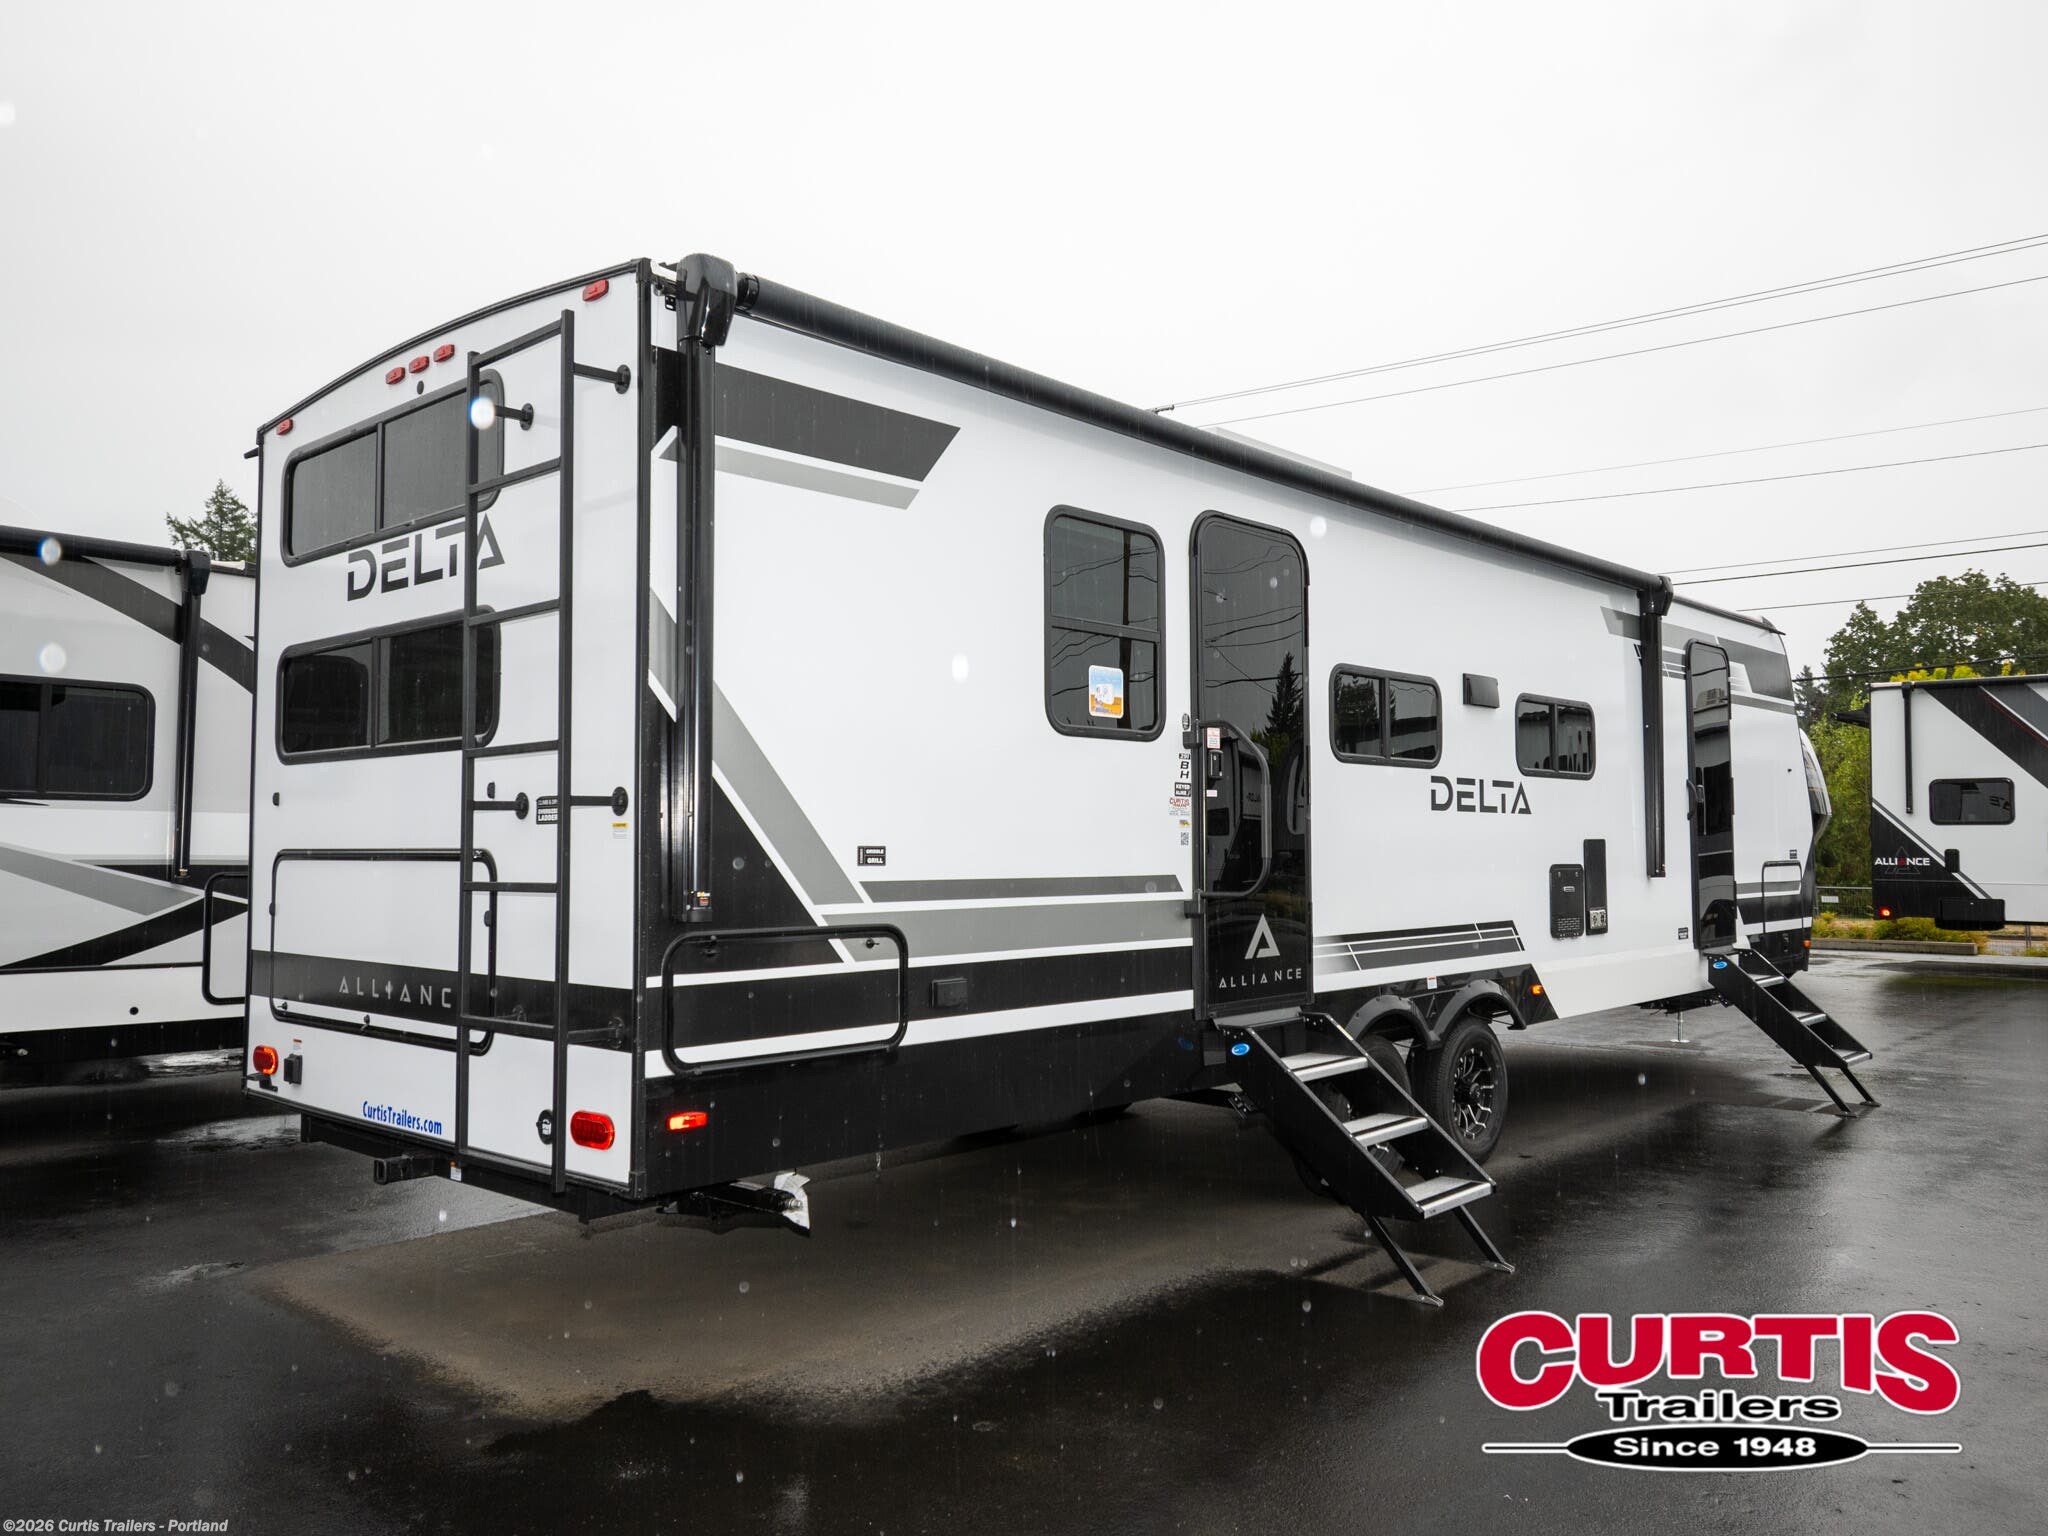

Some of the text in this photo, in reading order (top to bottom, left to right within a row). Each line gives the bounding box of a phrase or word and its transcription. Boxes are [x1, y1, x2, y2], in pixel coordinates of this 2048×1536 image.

[347, 513, 505, 601] DELTA
[1430, 775, 1532, 815] DELTA
[338, 975, 452, 1009] ALLIANC
[1219, 967, 1302, 989] ALLIANCE
[362, 1100, 442, 1136] CurtisTrailers.com
